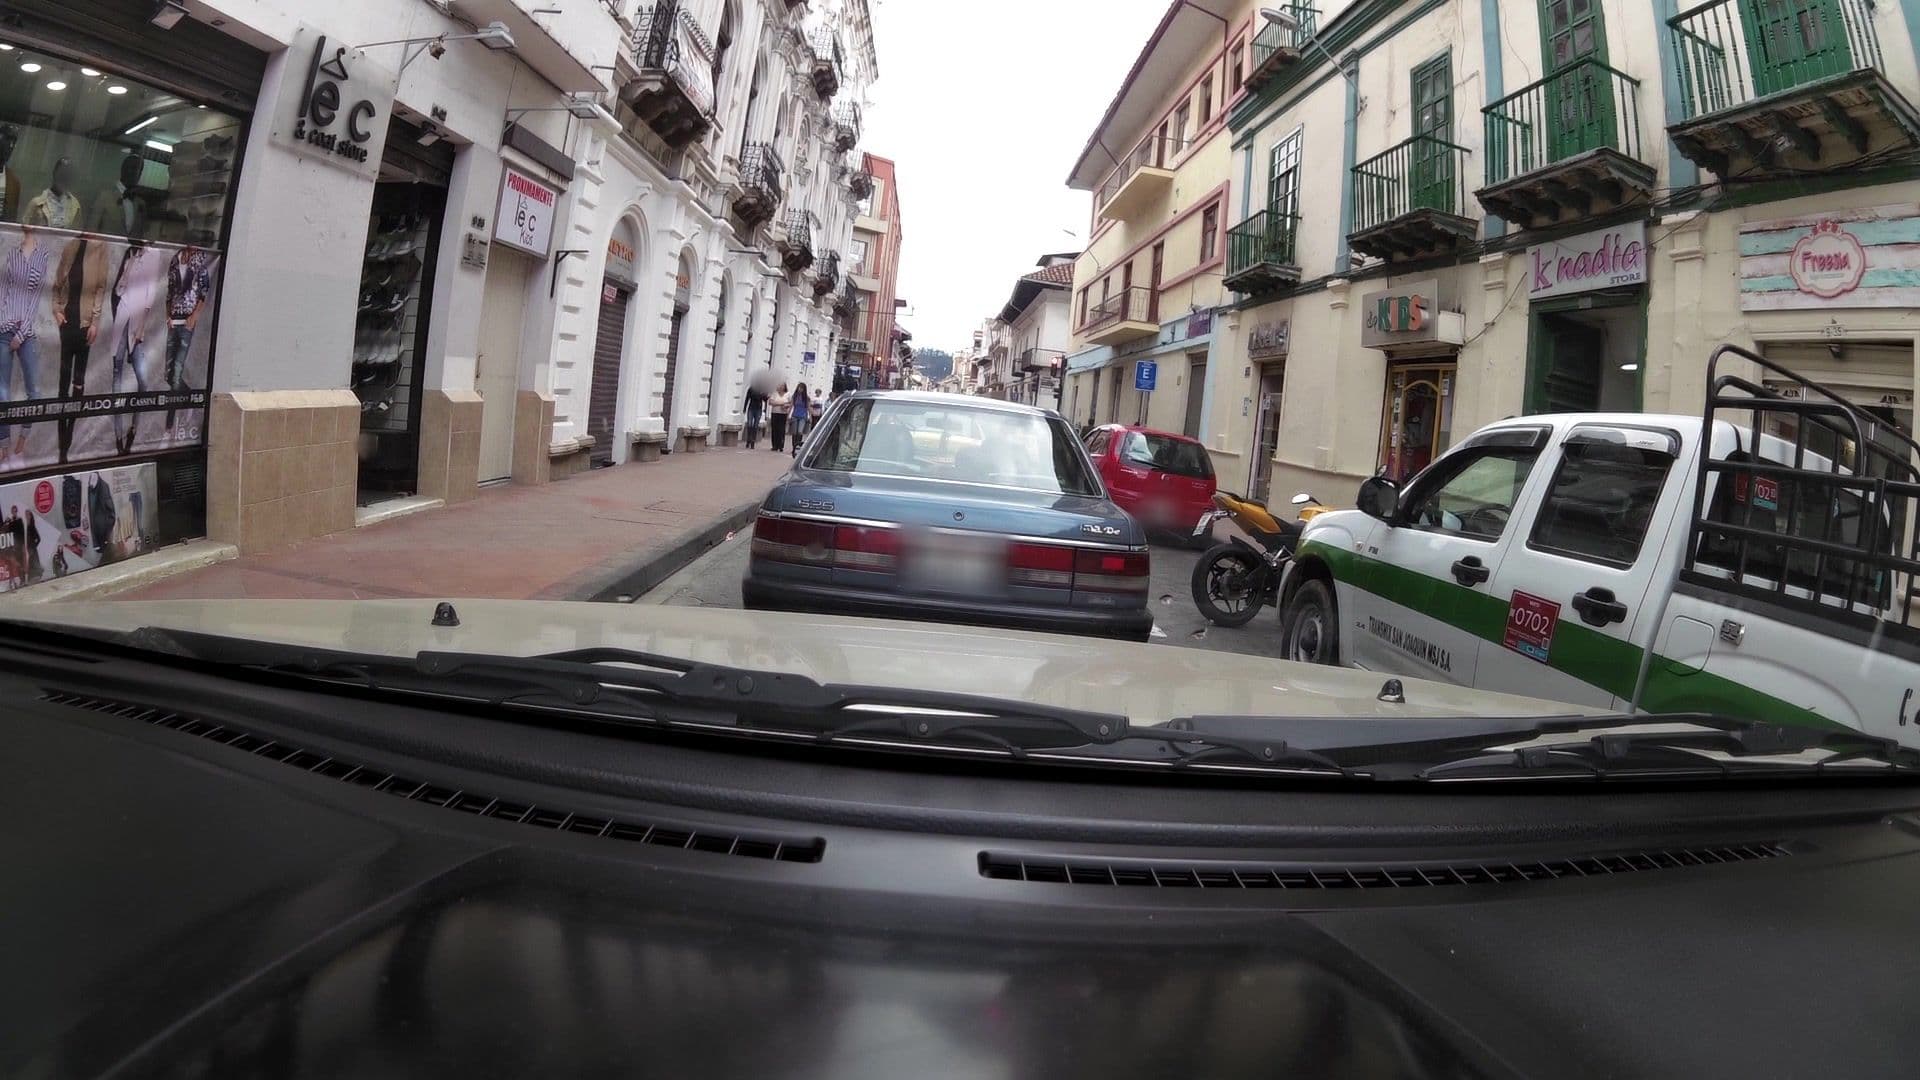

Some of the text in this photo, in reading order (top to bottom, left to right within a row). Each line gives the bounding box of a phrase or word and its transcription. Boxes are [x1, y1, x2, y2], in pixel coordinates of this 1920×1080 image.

[1609, 272, 1641, 285] STORE
[1377, 294, 1423, 332] KIDS
[1143, 368, 1150, 379] E
[83, 399, 111, 411] ALDO
[1515, 607, 1550, 635] 0702
[1392, 626, 1404, 649] SAN
